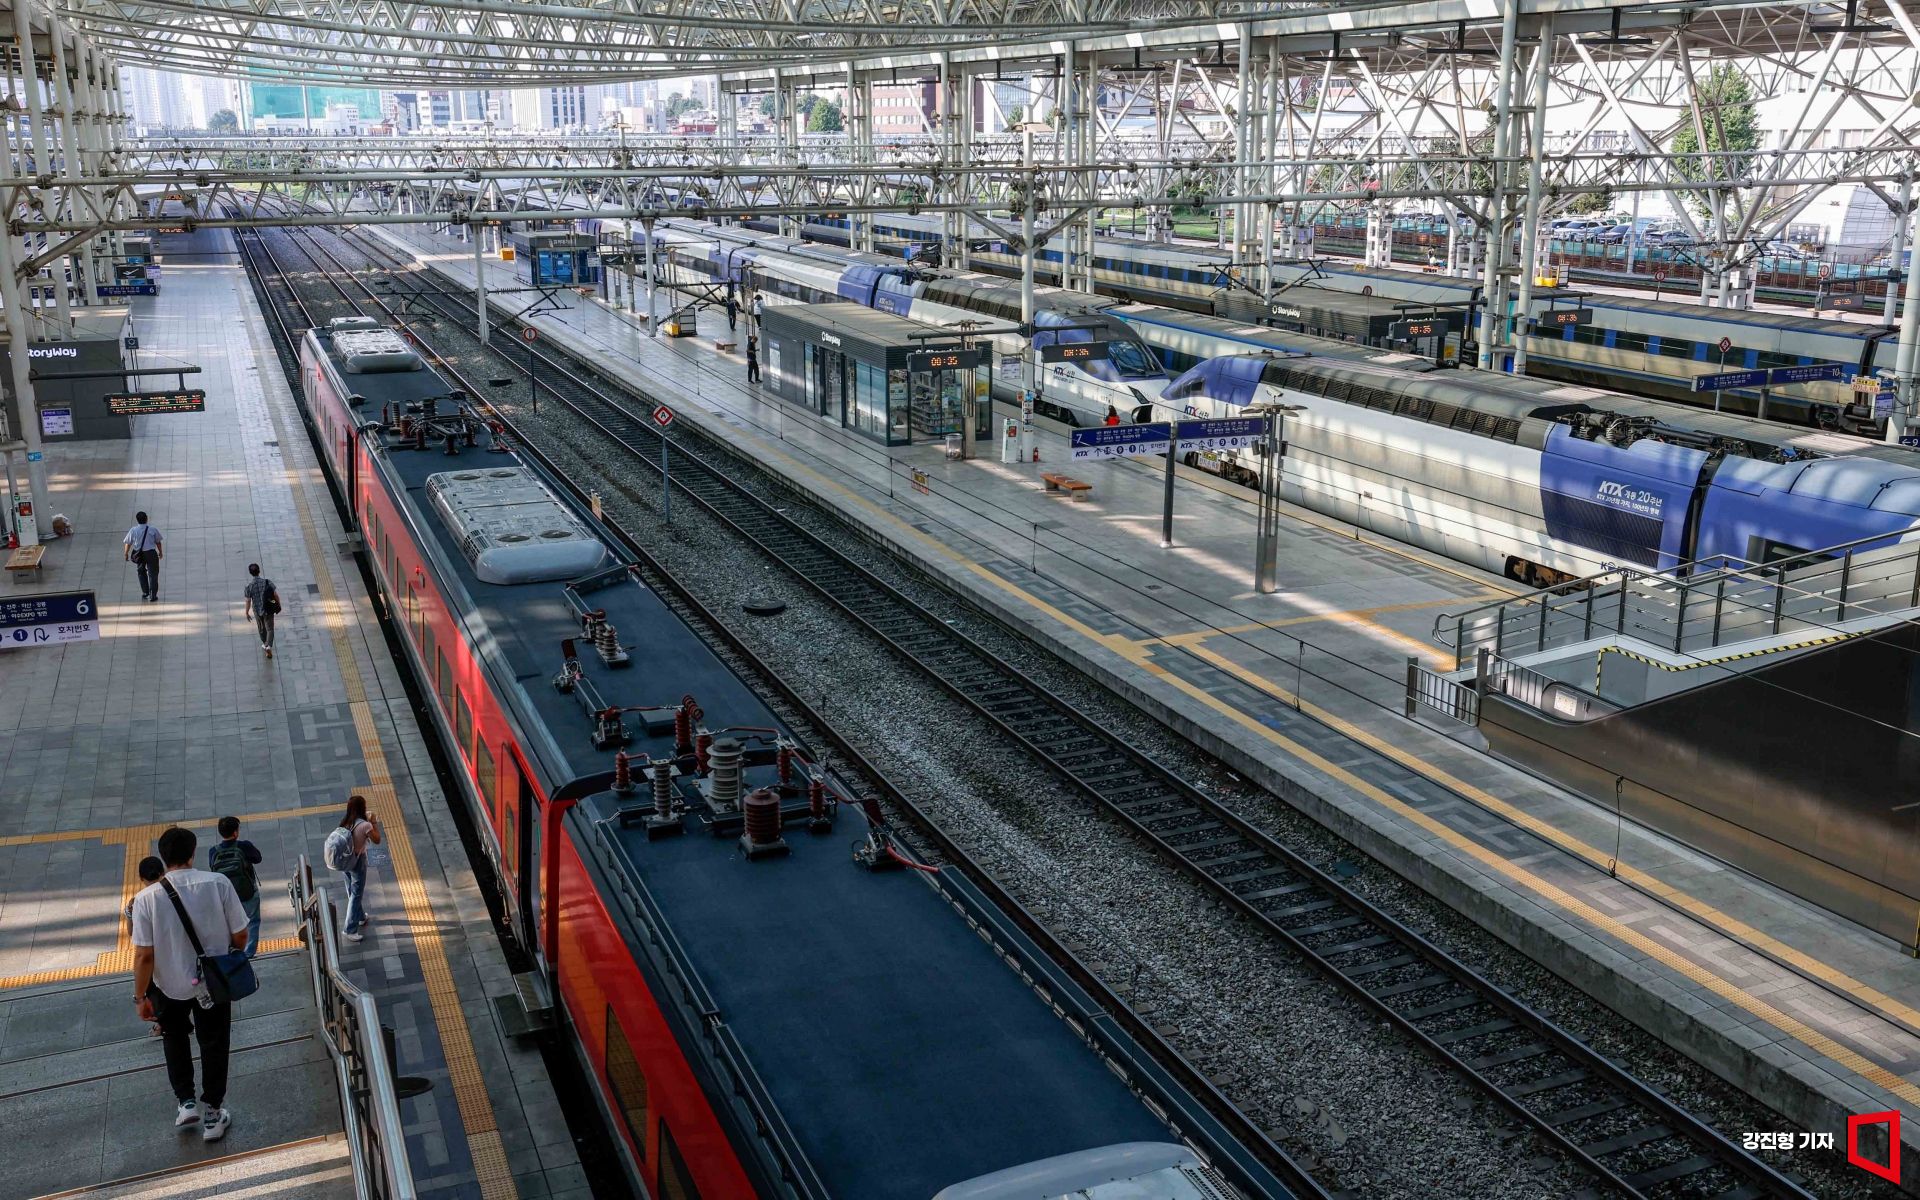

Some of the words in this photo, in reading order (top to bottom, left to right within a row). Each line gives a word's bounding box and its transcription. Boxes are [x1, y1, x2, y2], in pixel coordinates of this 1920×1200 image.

[1054, 365, 1068, 376] KTX
[1699, 380, 1706, 389] 9
[1183, 404, 1199, 417] KTX
[1076, 433, 1083, 444] 7
[1912, 438, 1919, 447] 9
[1599, 480, 1631, 497] KTX
[76, 599, 89, 615] 6
[58, 623, 91, 634] 호차번호
